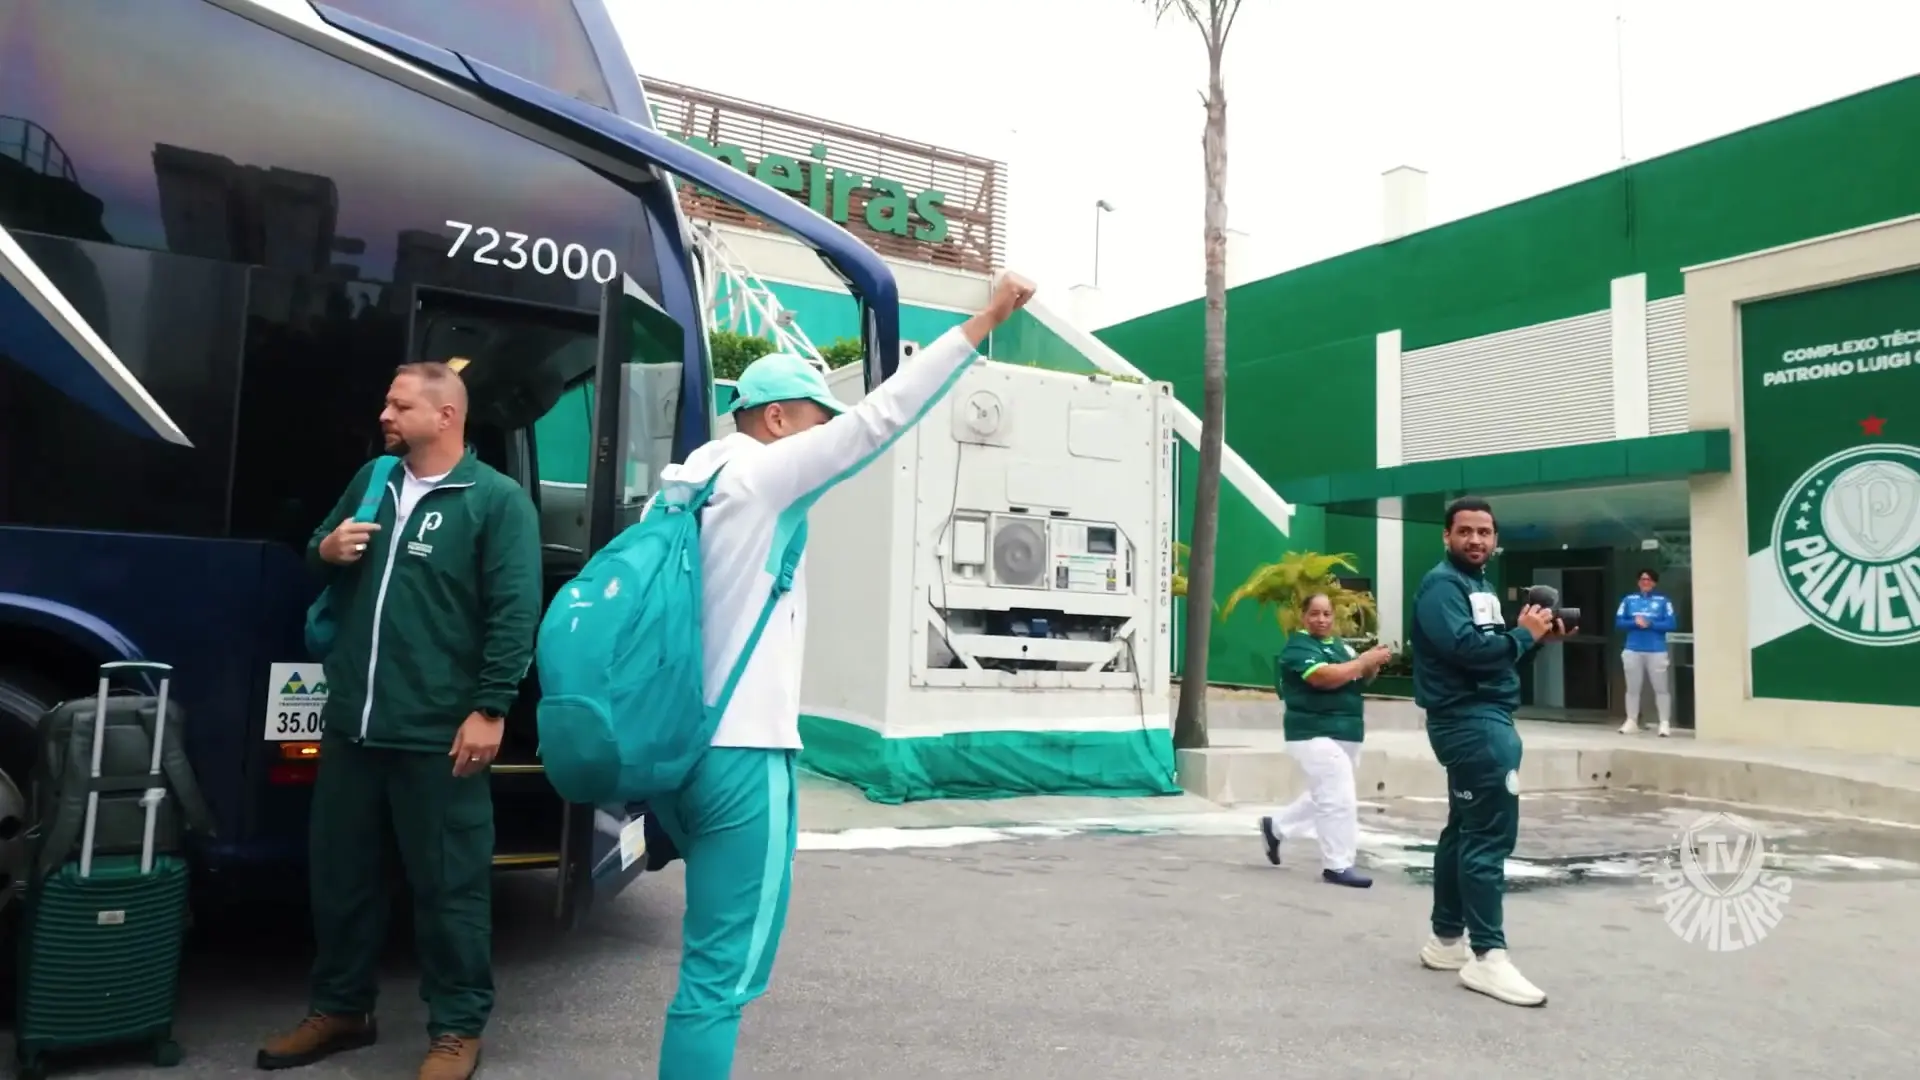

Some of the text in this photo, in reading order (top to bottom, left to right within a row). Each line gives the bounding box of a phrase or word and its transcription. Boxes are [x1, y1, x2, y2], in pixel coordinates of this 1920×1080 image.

[446, 220, 617, 284] 723000
[1782, 330, 1920, 363] COMPLEXO TÉC
[1763, 360, 1854, 386] PATRONO
[1857, 351, 1911, 373] LUIGI
